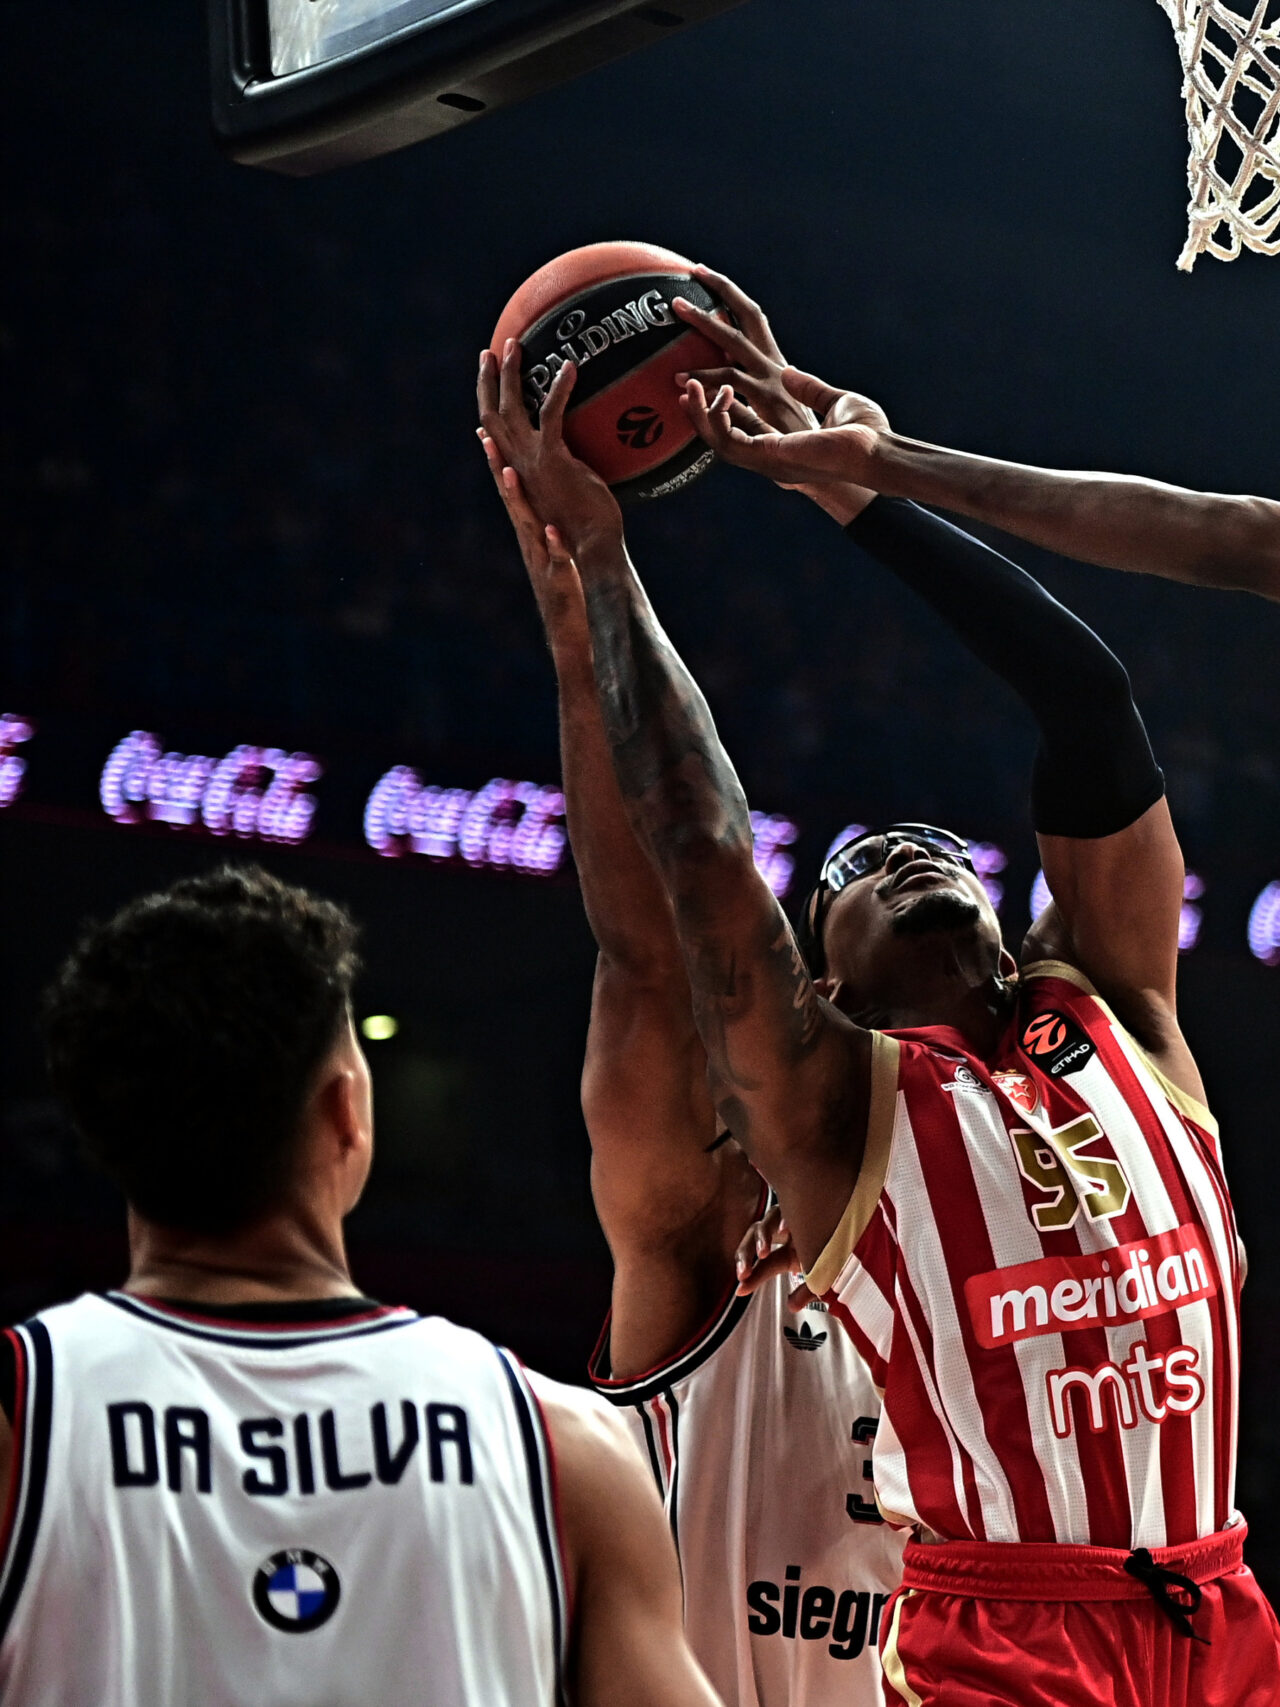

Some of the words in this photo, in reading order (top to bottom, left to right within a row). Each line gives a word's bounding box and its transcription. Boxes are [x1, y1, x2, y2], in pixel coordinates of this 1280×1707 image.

[526, 289, 676, 409] PALDING
[1051, 1043, 1090, 1074] ETIHAD
[1008, 1111, 1132, 1232] 95
[989, 1248, 1209, 1338] meridian
[1049, 1345, 1201, 1434] mts
[107, 1401, 211, 1494] DA
[239, 1400, 475, 1497] SILVA
